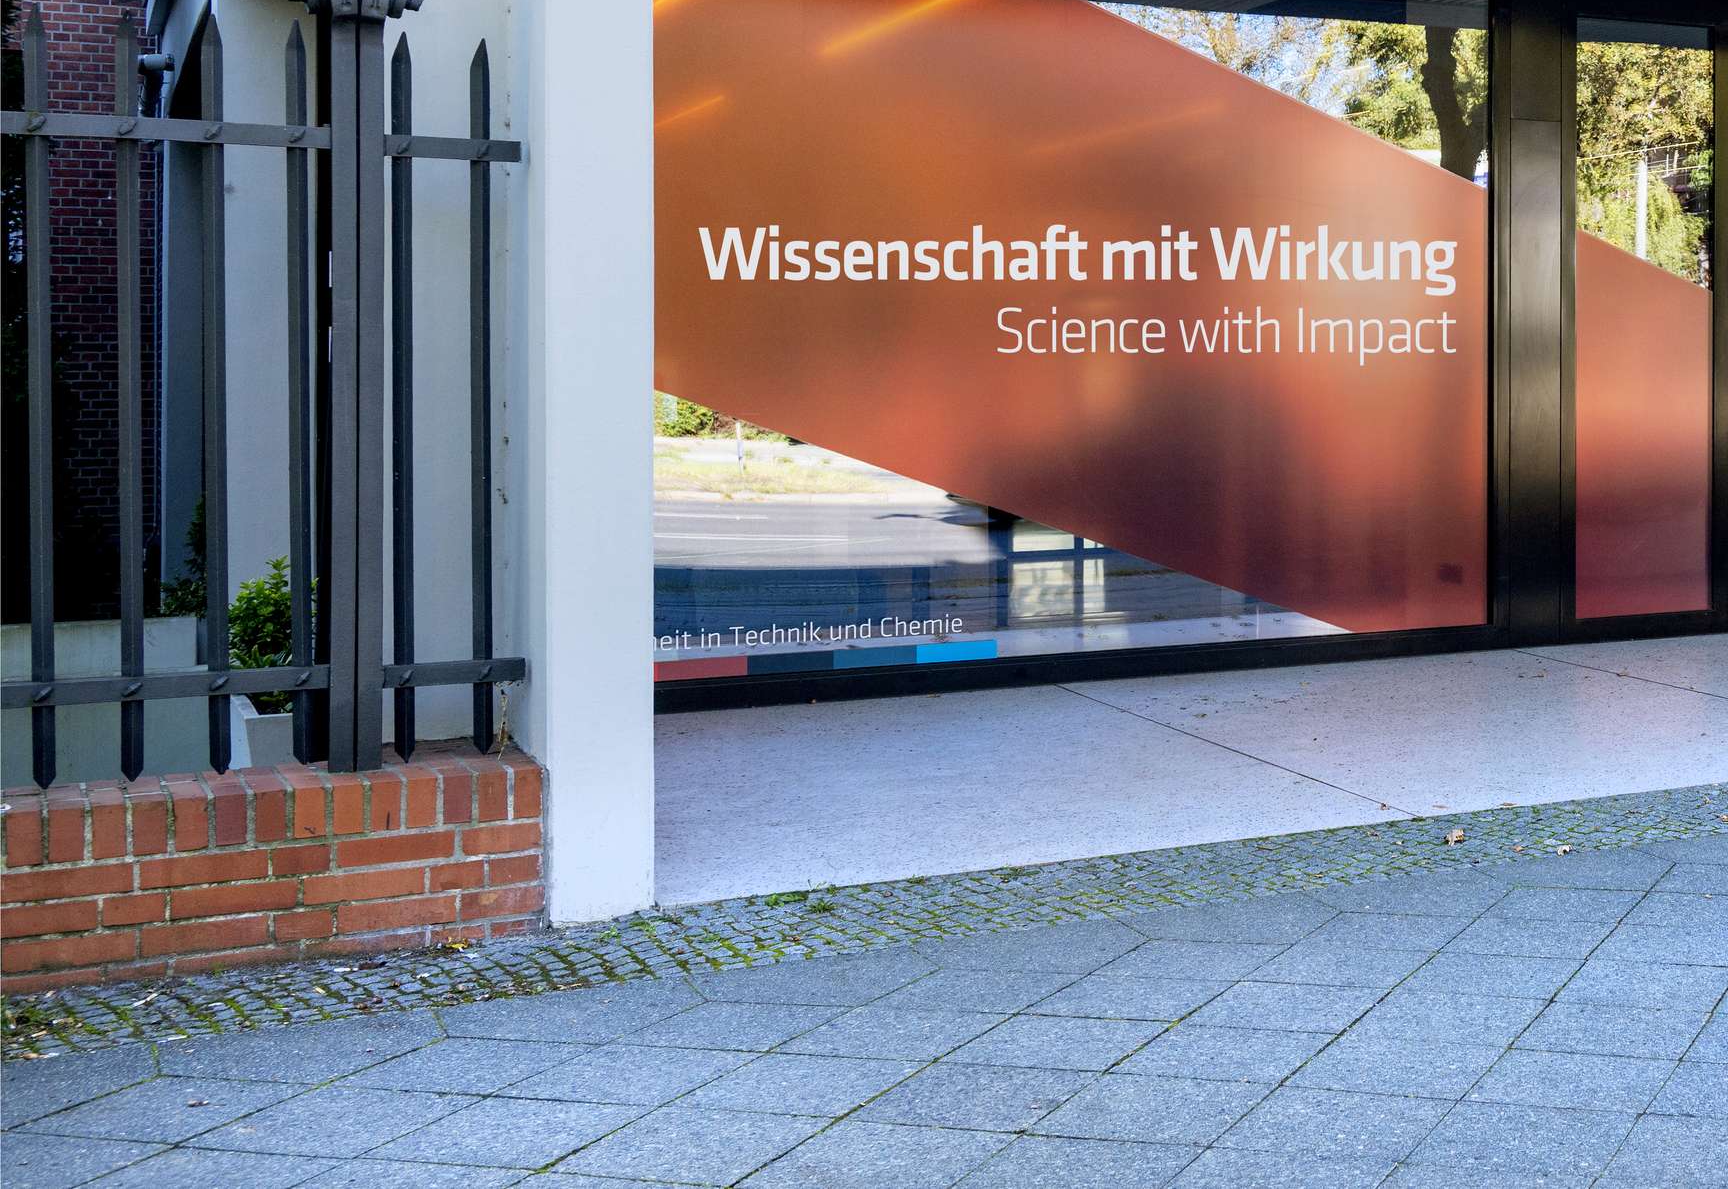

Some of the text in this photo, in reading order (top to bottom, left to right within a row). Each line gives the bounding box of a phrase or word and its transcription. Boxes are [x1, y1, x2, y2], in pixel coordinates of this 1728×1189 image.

[698, 224, 1458, 296] Wissenschaft mit Wirkung
[996, 306, 1457, 367] Science with Impact
[700, 627, 721, 649] in
[728, 621, 821, 647] Technik
[829, 618, 872, 640] und
[880, 613, 963, 638] Chemie
